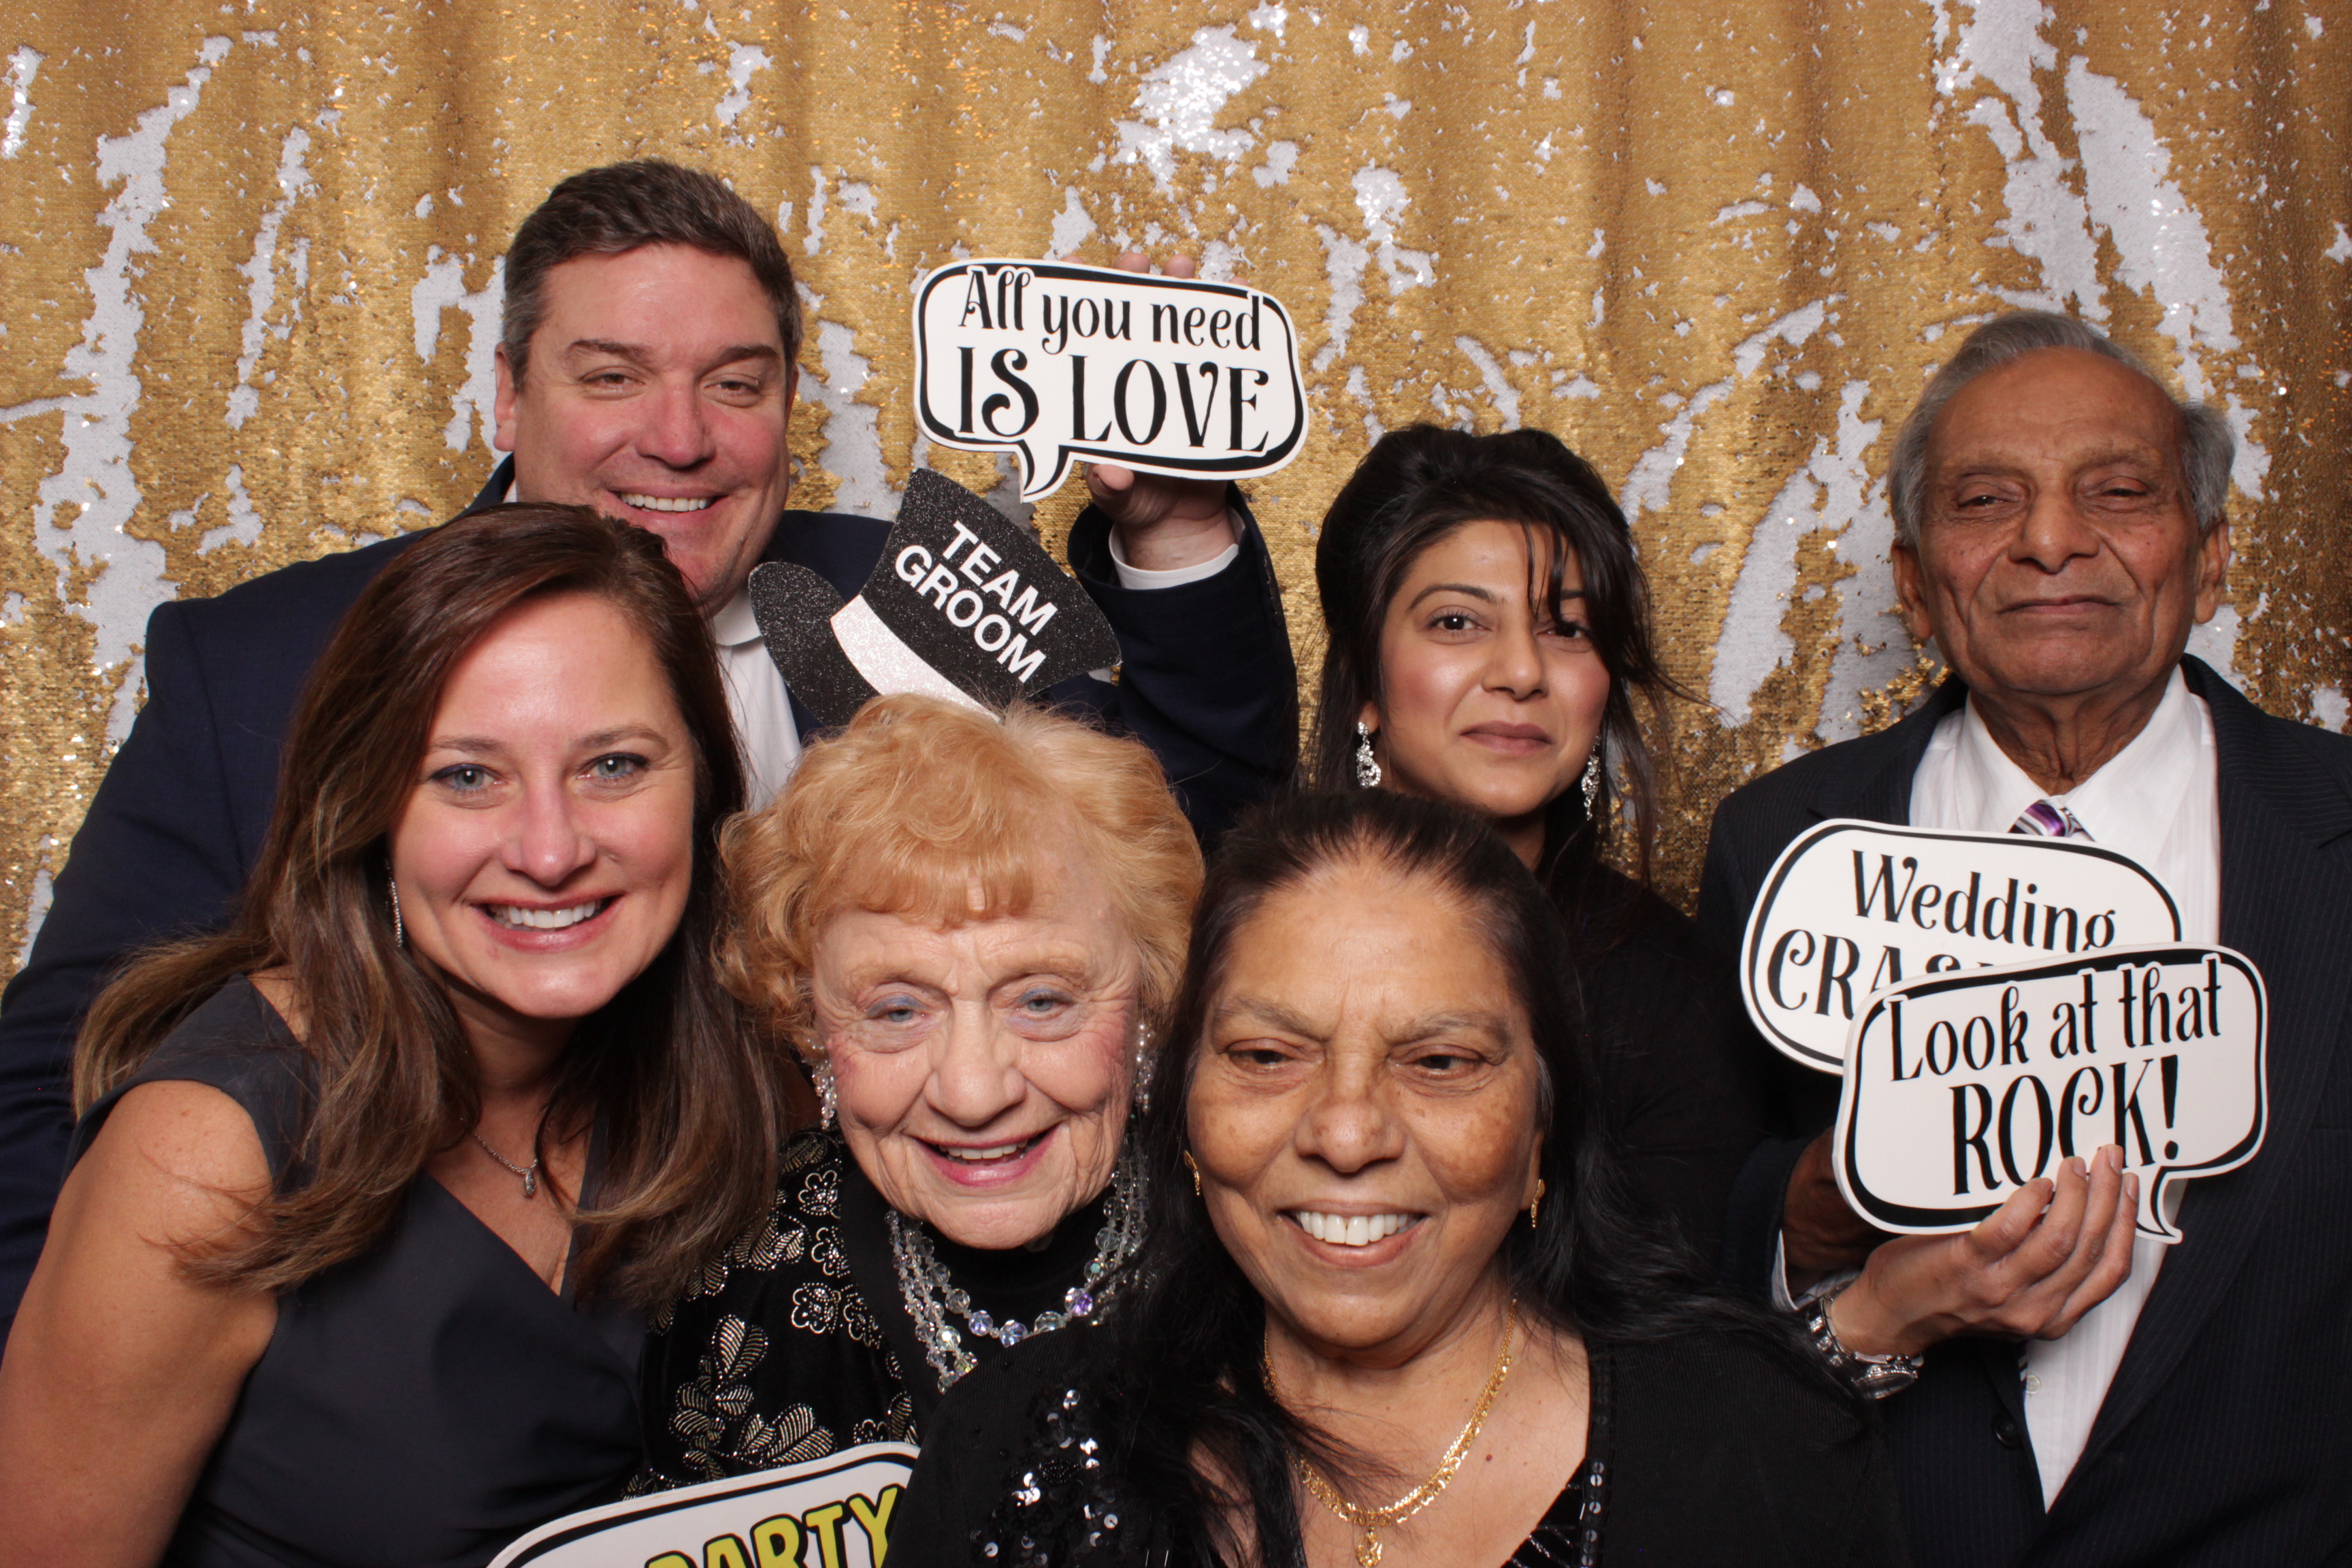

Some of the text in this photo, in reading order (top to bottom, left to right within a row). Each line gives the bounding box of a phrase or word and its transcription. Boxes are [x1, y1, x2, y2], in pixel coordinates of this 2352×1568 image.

[958, 270, 1262, 355] All you need
[956, 346, 1269, 453] IS LOVE
[895, 544, 1047, 683] GROOM
[942, 520, 1058, 636] TEAM
[1851, 849, 2116, 953] Wedding
[1887, 958, 2222, 1082] Look at that
[1948, 1054, 2178, 1196] ROCK!
